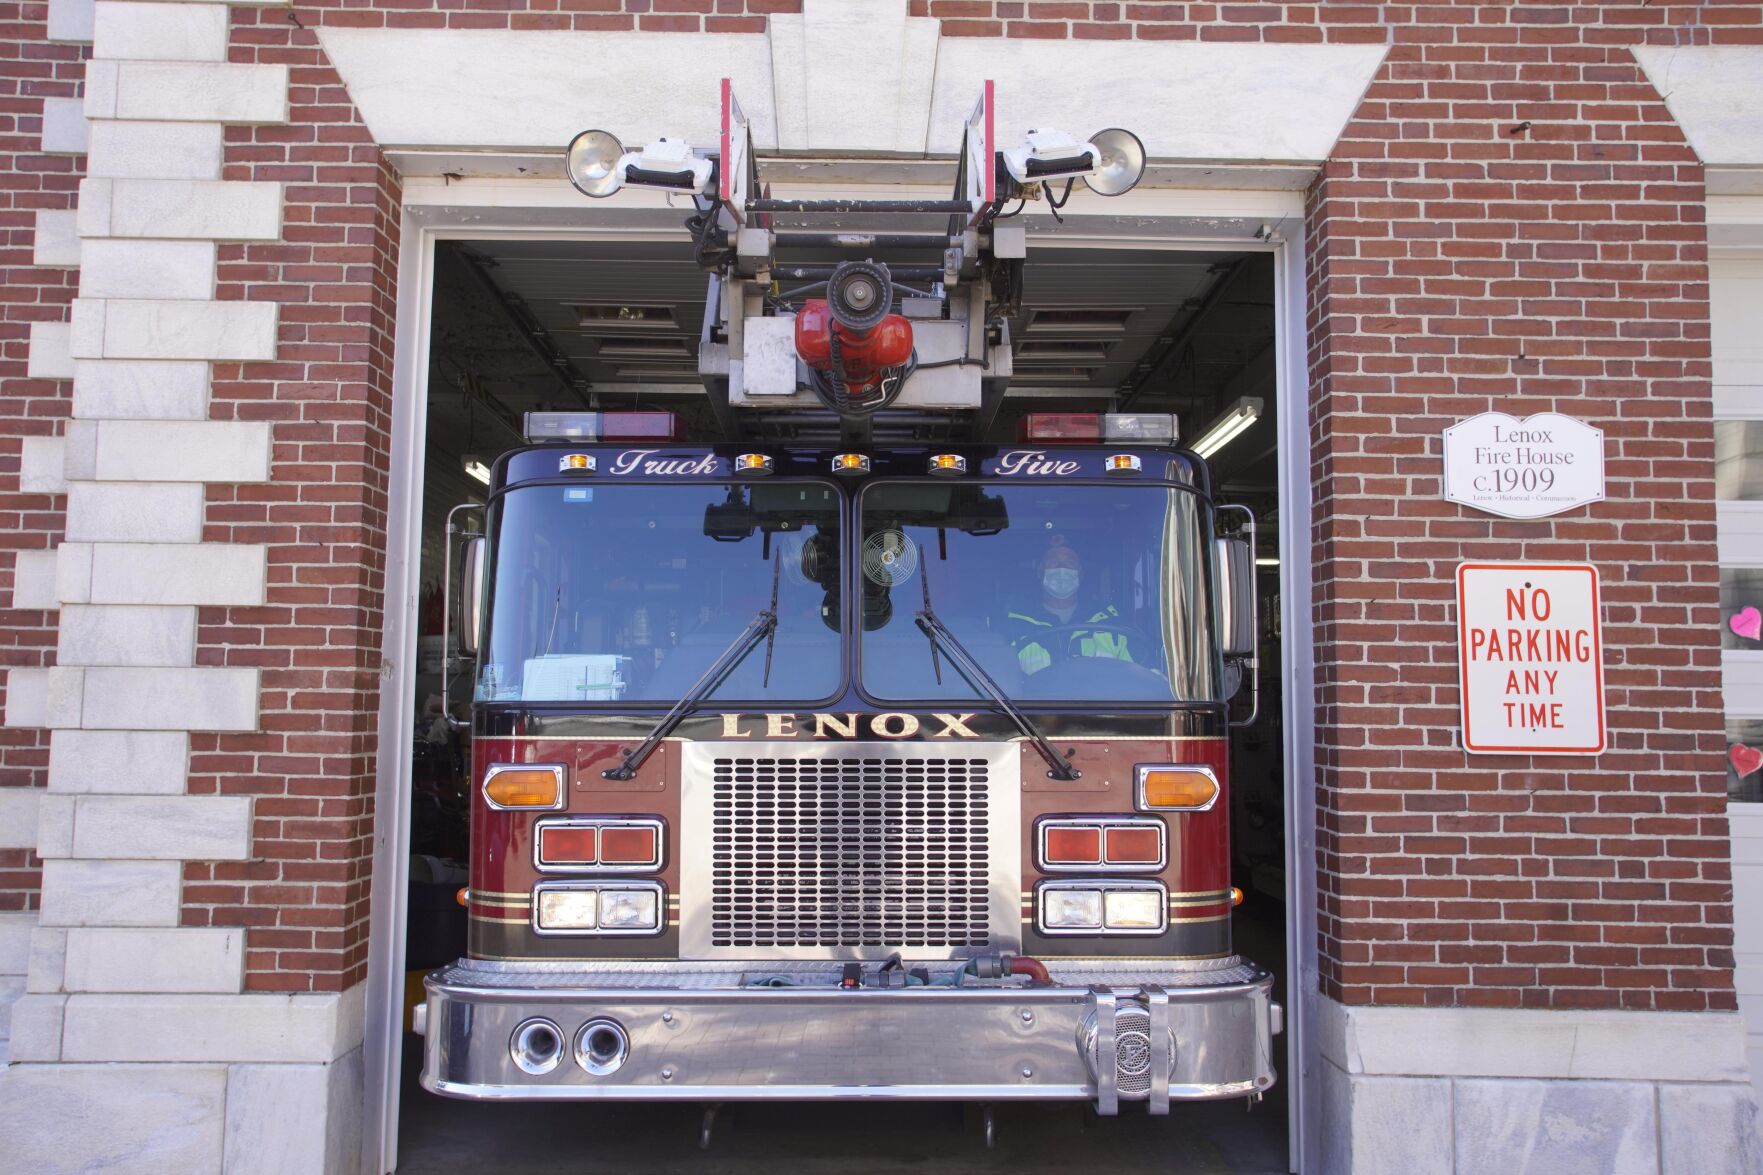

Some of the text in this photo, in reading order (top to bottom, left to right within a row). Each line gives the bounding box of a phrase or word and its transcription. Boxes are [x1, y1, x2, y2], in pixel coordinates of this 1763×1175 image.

[1494, 425, 1554, 444] Lenox
[609, 449, 1082, 475] Truck Five
[1475, 447, 1575, 465] Fire House
[1506, 588, 1551, 622] NO
[1470, 628, 1590, 663] PARKING
[1505, 670, 1559, 695] ANY
[720, 712, 981, 740] LENOX
[1503, 703, 1564, 728] TIME
